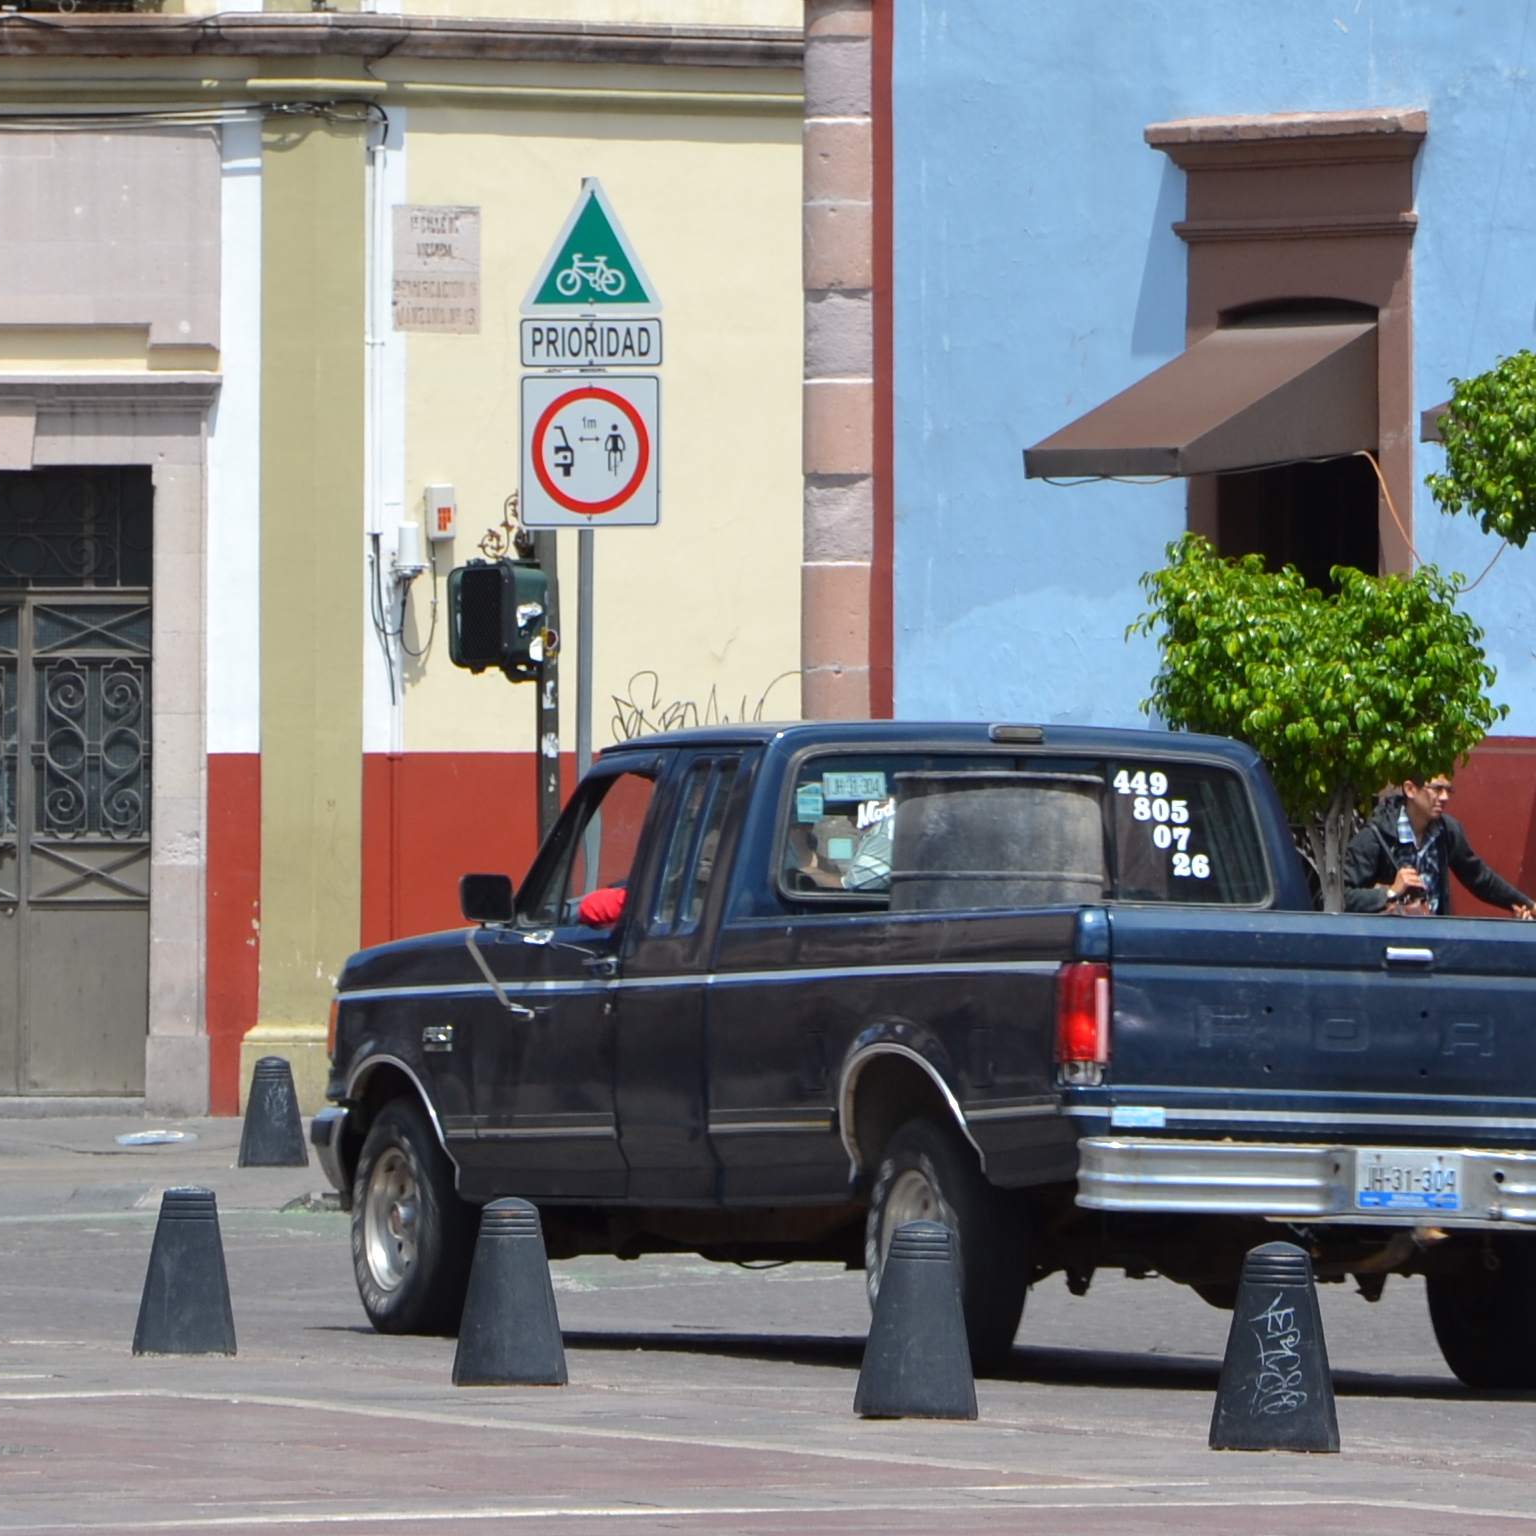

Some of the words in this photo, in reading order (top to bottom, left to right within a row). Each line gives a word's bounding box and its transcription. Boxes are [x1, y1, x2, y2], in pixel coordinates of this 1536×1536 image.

[531, 326, 651, 358] PRIORIDAD
[581, 415, 597, 429] 1m
[1113, 769, 1168, 796] 449
[1133, 797, 1189, 824] 805
[1153, 825, 1191, 852] 07
[1172, 853, 1211, 879] 26
[1363, 1165, 1456, 1193] JH-31-304
